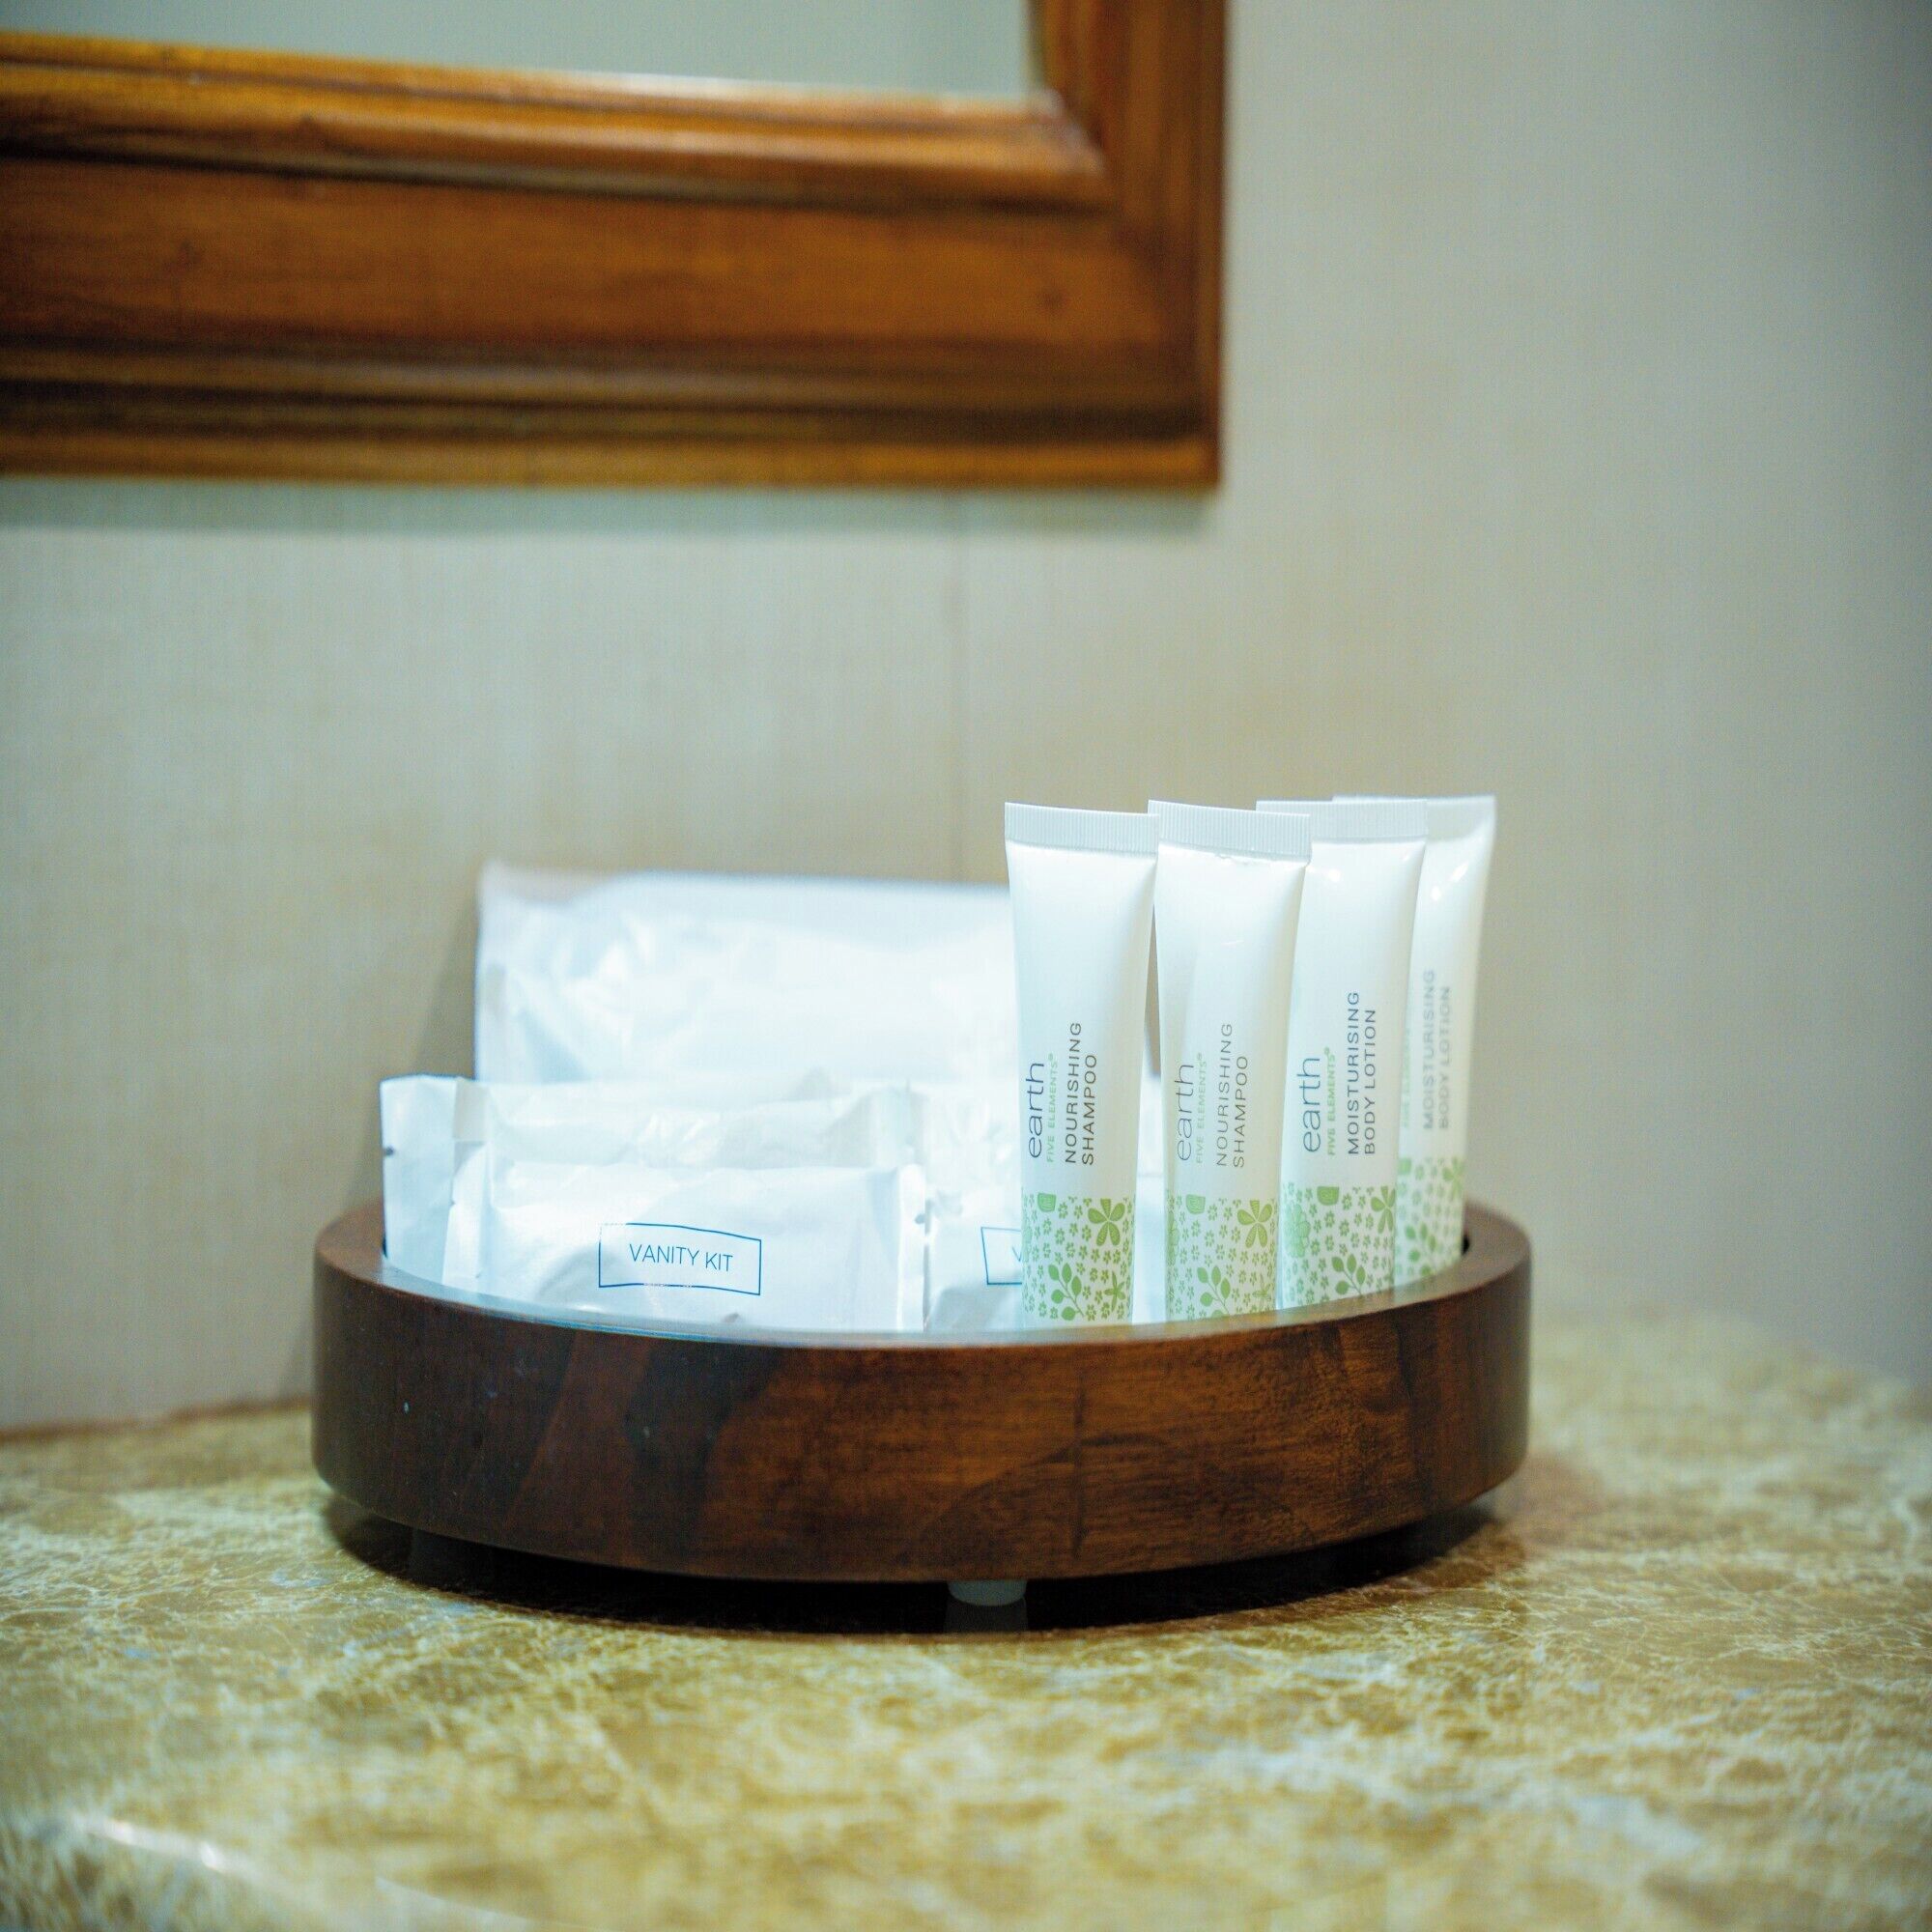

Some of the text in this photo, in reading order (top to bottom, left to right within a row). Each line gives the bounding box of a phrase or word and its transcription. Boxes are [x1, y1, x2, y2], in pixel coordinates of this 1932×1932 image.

[1065, 1022, 1082, 1164] NOURISHING
[1216, 1023, 1233, 1167] NOURISHING
[1296, 1056, 1321, 1152] earth
[1348, 991, 1360, 1154] MOISTURISING
[1364, 1009, 1377, 1154] BODY LOTION
[1422, 969, 1435, 1130] MOISTURISING
[1438, 985, 1451, 1130] BODY LOTION
[1025, 1062, 1045, 1158] earth
[1046, 1136, 1056, 1163] FIVE
[1081, 1054, 1097, 1166] SHAMPOO
[1174, 1064, 1195, 1161] earth
[1195, 1137, 1205, 1164] FIVE
[1233, 1056, 1248, 1168] SHAMPOO
[1326, 1127, 1336, 1156] FIVE
[629, 1243, 734, 1272] VANITY KIT
